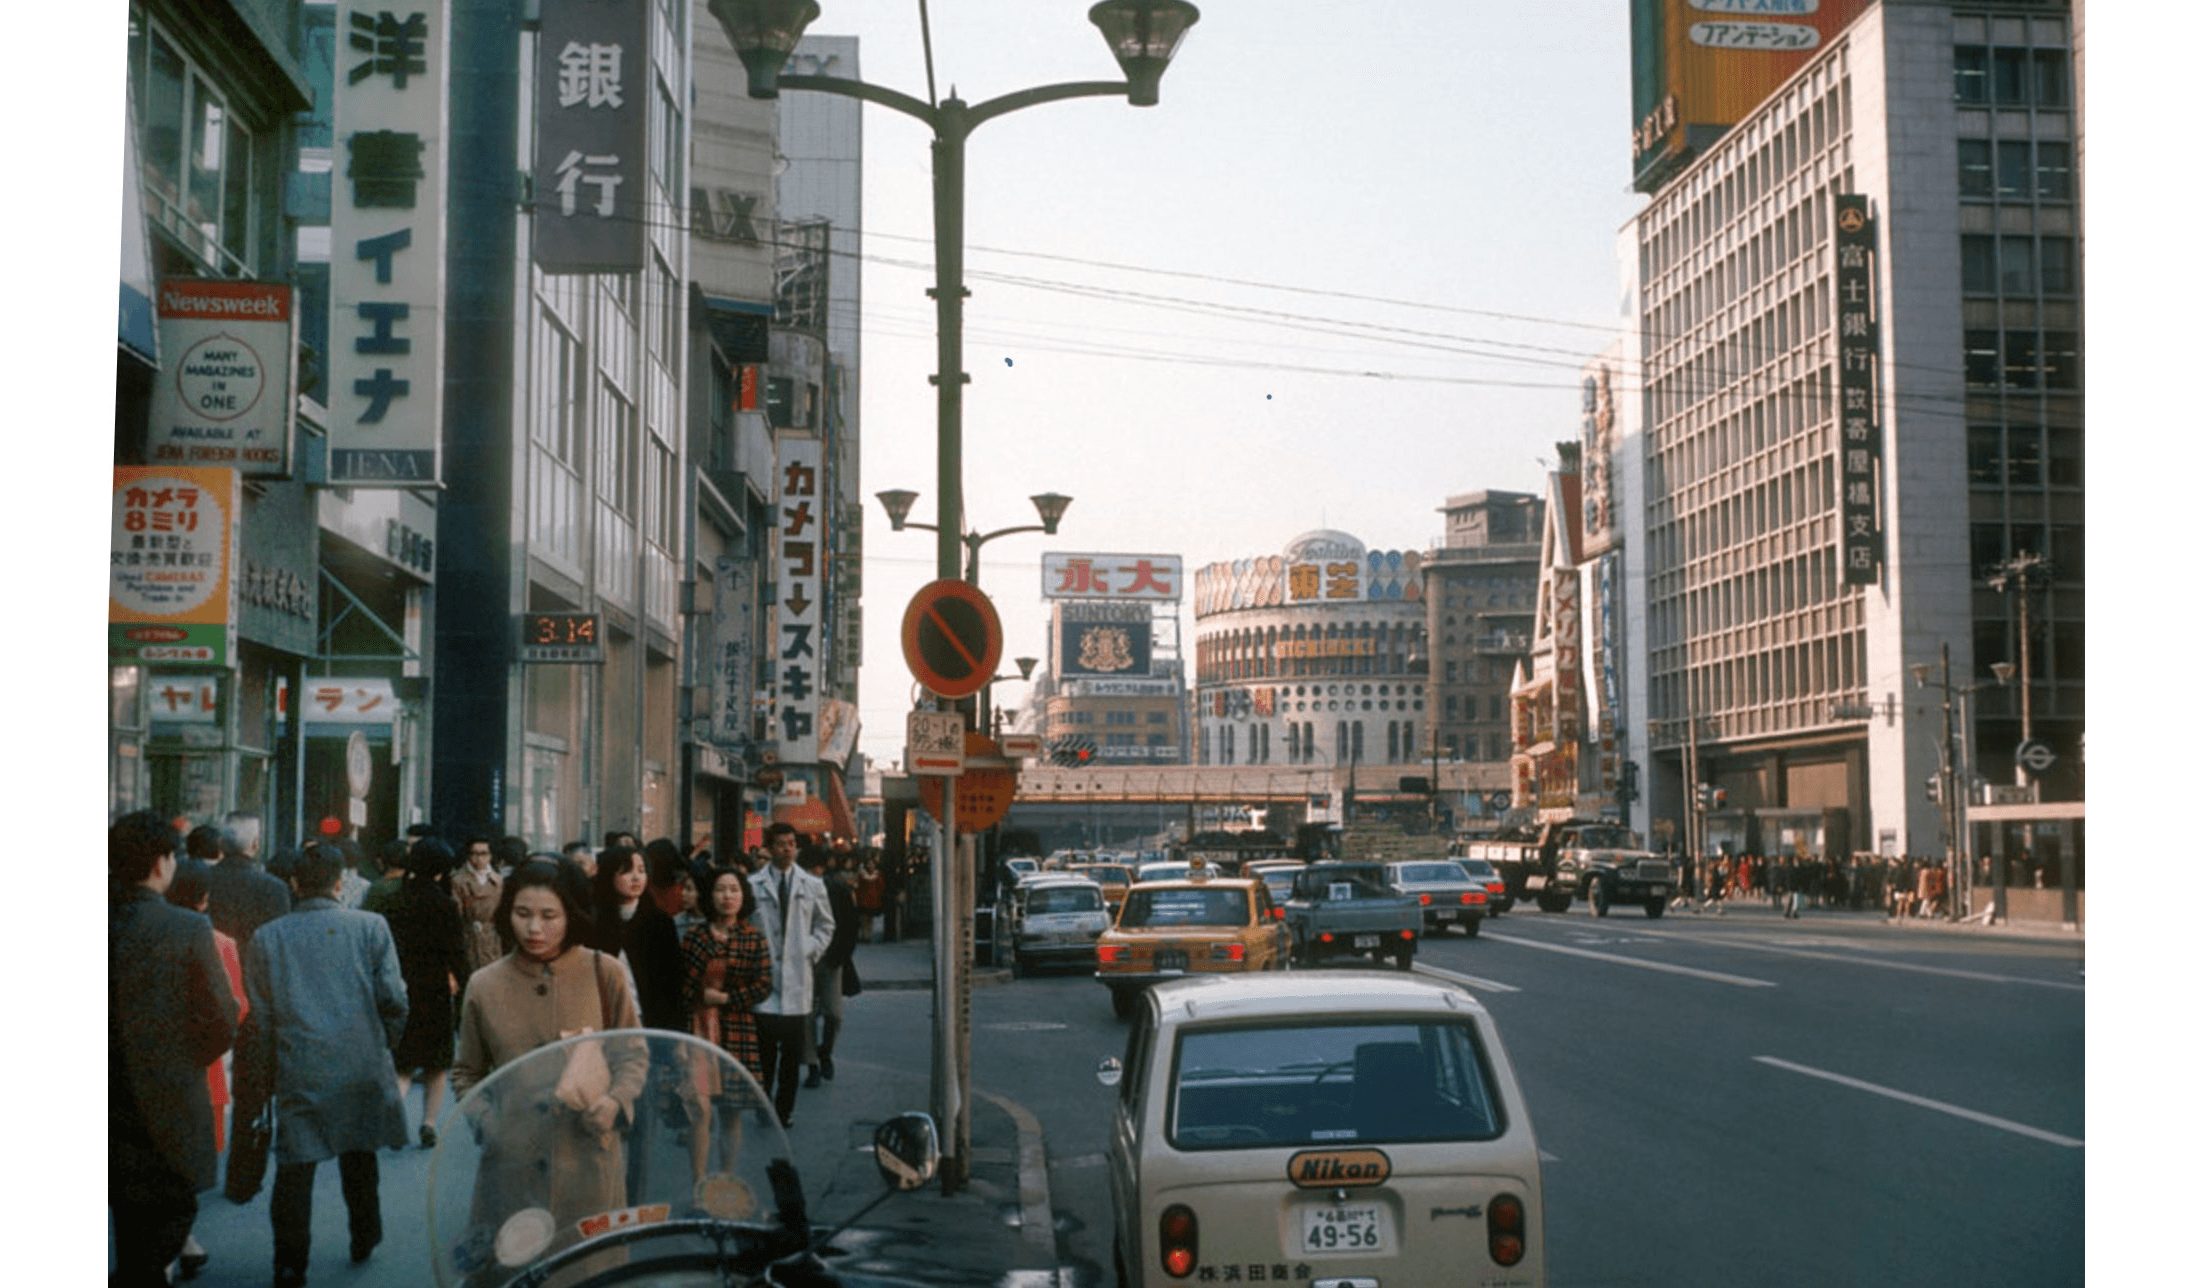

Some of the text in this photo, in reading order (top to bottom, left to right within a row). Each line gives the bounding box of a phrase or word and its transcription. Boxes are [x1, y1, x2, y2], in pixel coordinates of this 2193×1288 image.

[557, 40, 624, 217] 銀行
[163, 291, 280, 315] Newsweek
[203, 351, 238, 361] MANY
[184, 365, 255, 378] MAGAZINES
[212, 381, 226, 391] IN
[200, 395, 237, 410] ONE
[170, 426, 262, 440] AVAILABLE AT
[125, 487, 199, 509] カメラ
[124, 510, 198, 533] 8ミリ
[1055, 559, 1172, 593] 永大
[1062, 604, 1150, 622] SUNTORY
[1301, 1159, 1380, 1179] Nikon
[1308, 1224, 1378, 1248] 49-56
